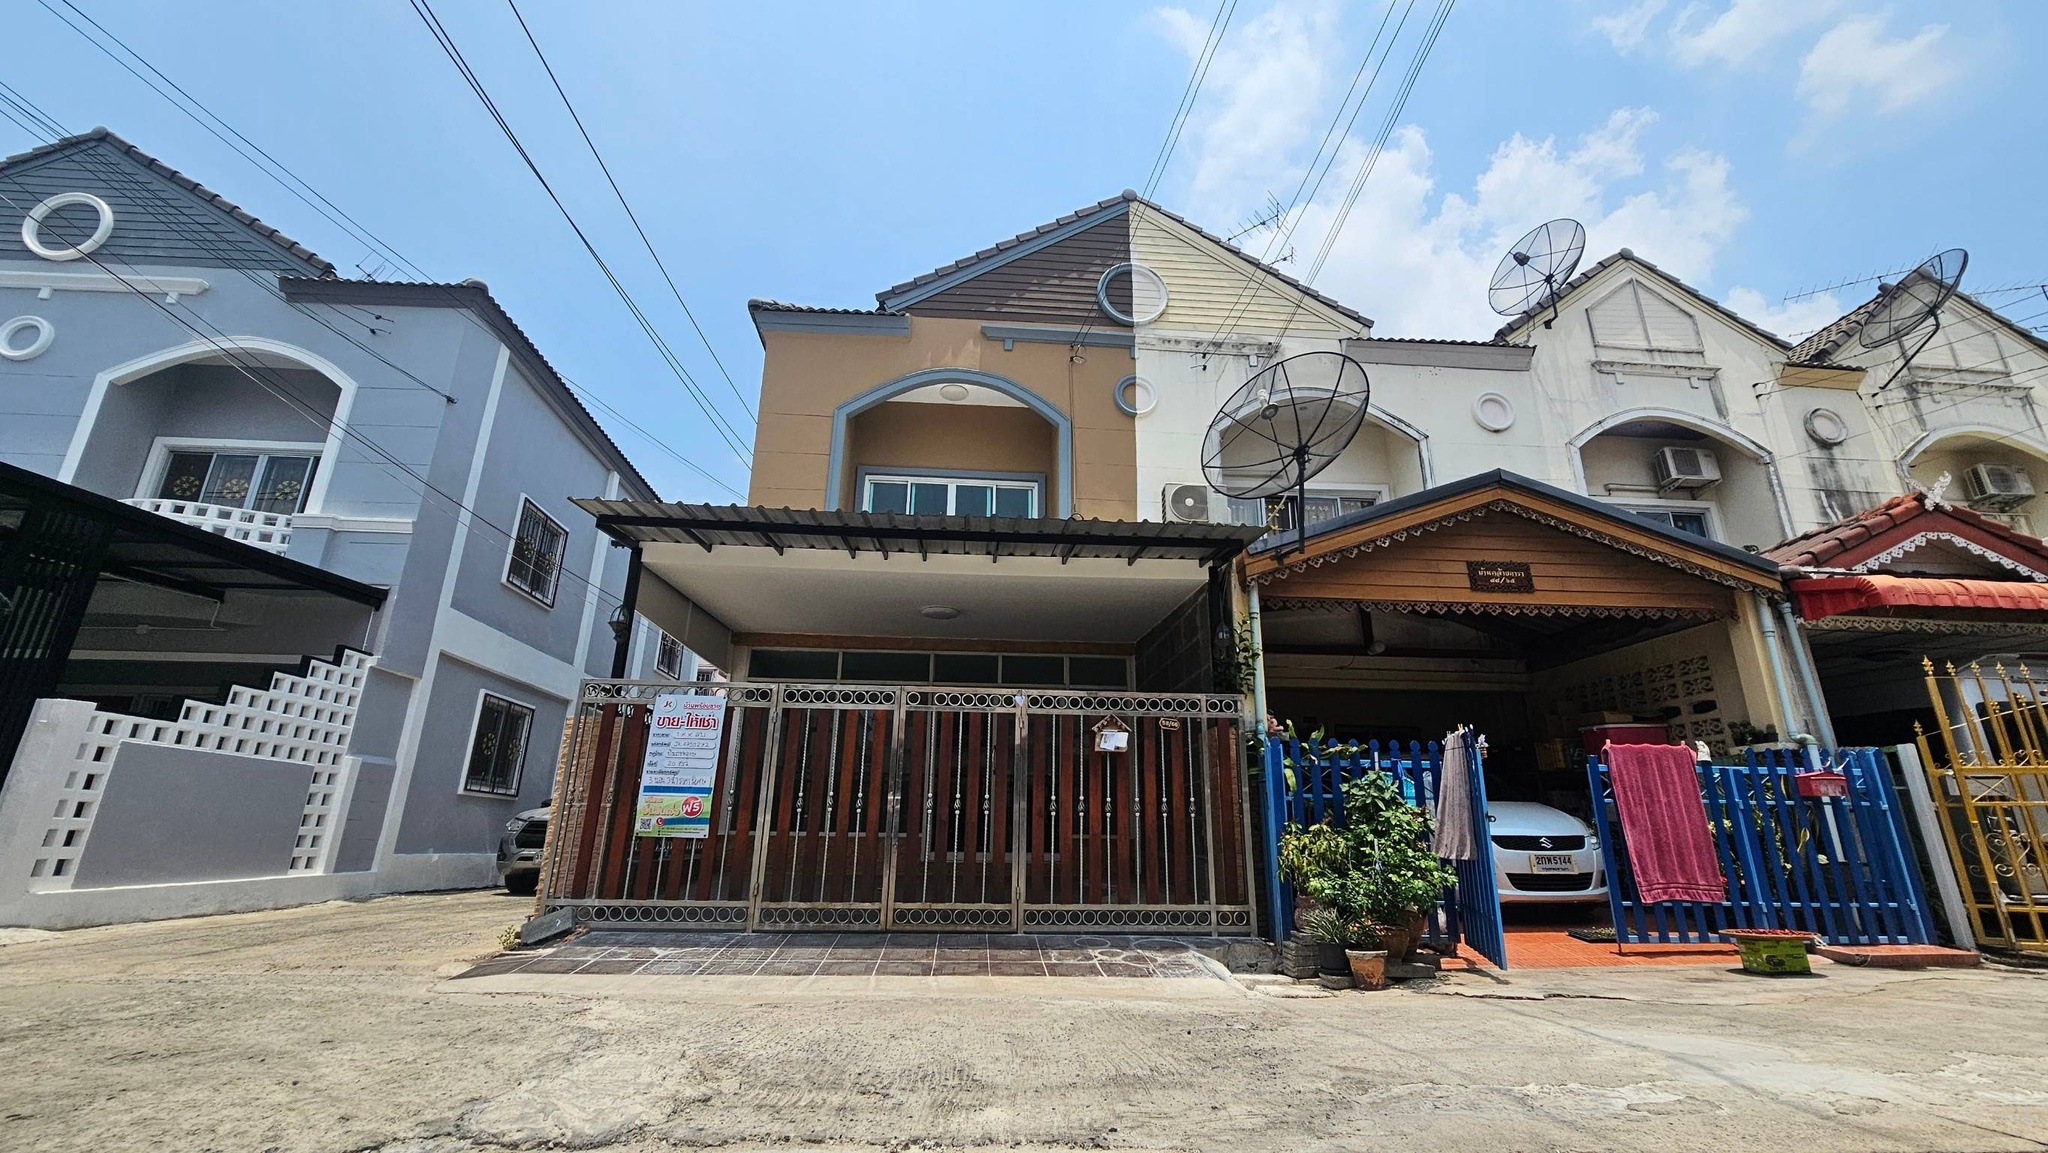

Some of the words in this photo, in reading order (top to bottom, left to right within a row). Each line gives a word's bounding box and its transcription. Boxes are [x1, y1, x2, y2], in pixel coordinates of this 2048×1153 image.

[656, 712, 718, 729] ขาย-ให้เช่า
[1553, 856, 1572, 865] 5144
